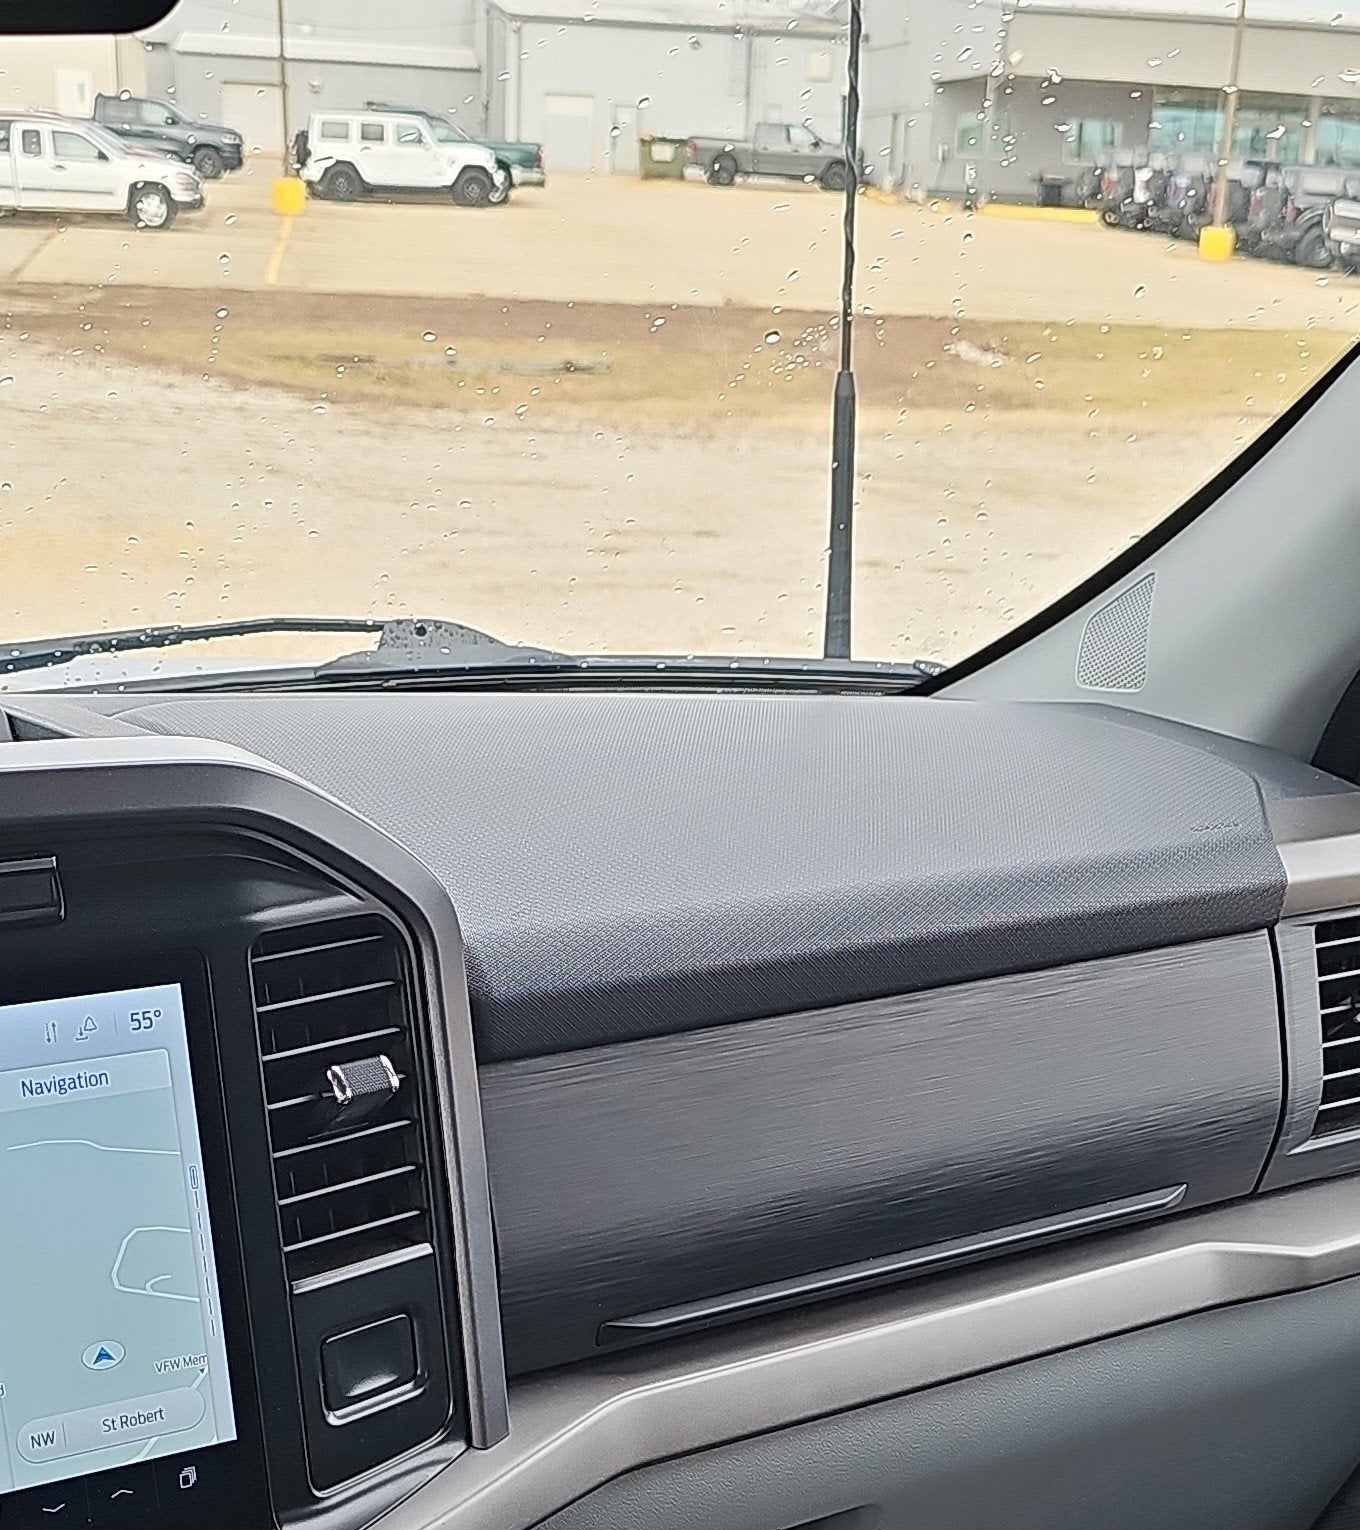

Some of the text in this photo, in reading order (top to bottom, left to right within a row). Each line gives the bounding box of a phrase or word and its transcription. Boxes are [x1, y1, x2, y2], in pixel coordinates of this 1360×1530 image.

[130, 1009, 162, 1032] 55°
[21, 1071, 110, 1098] Navigation
[155, 1358, 181, 1373] VFW
[30, 1407, 165, 1449] NW St Robert
